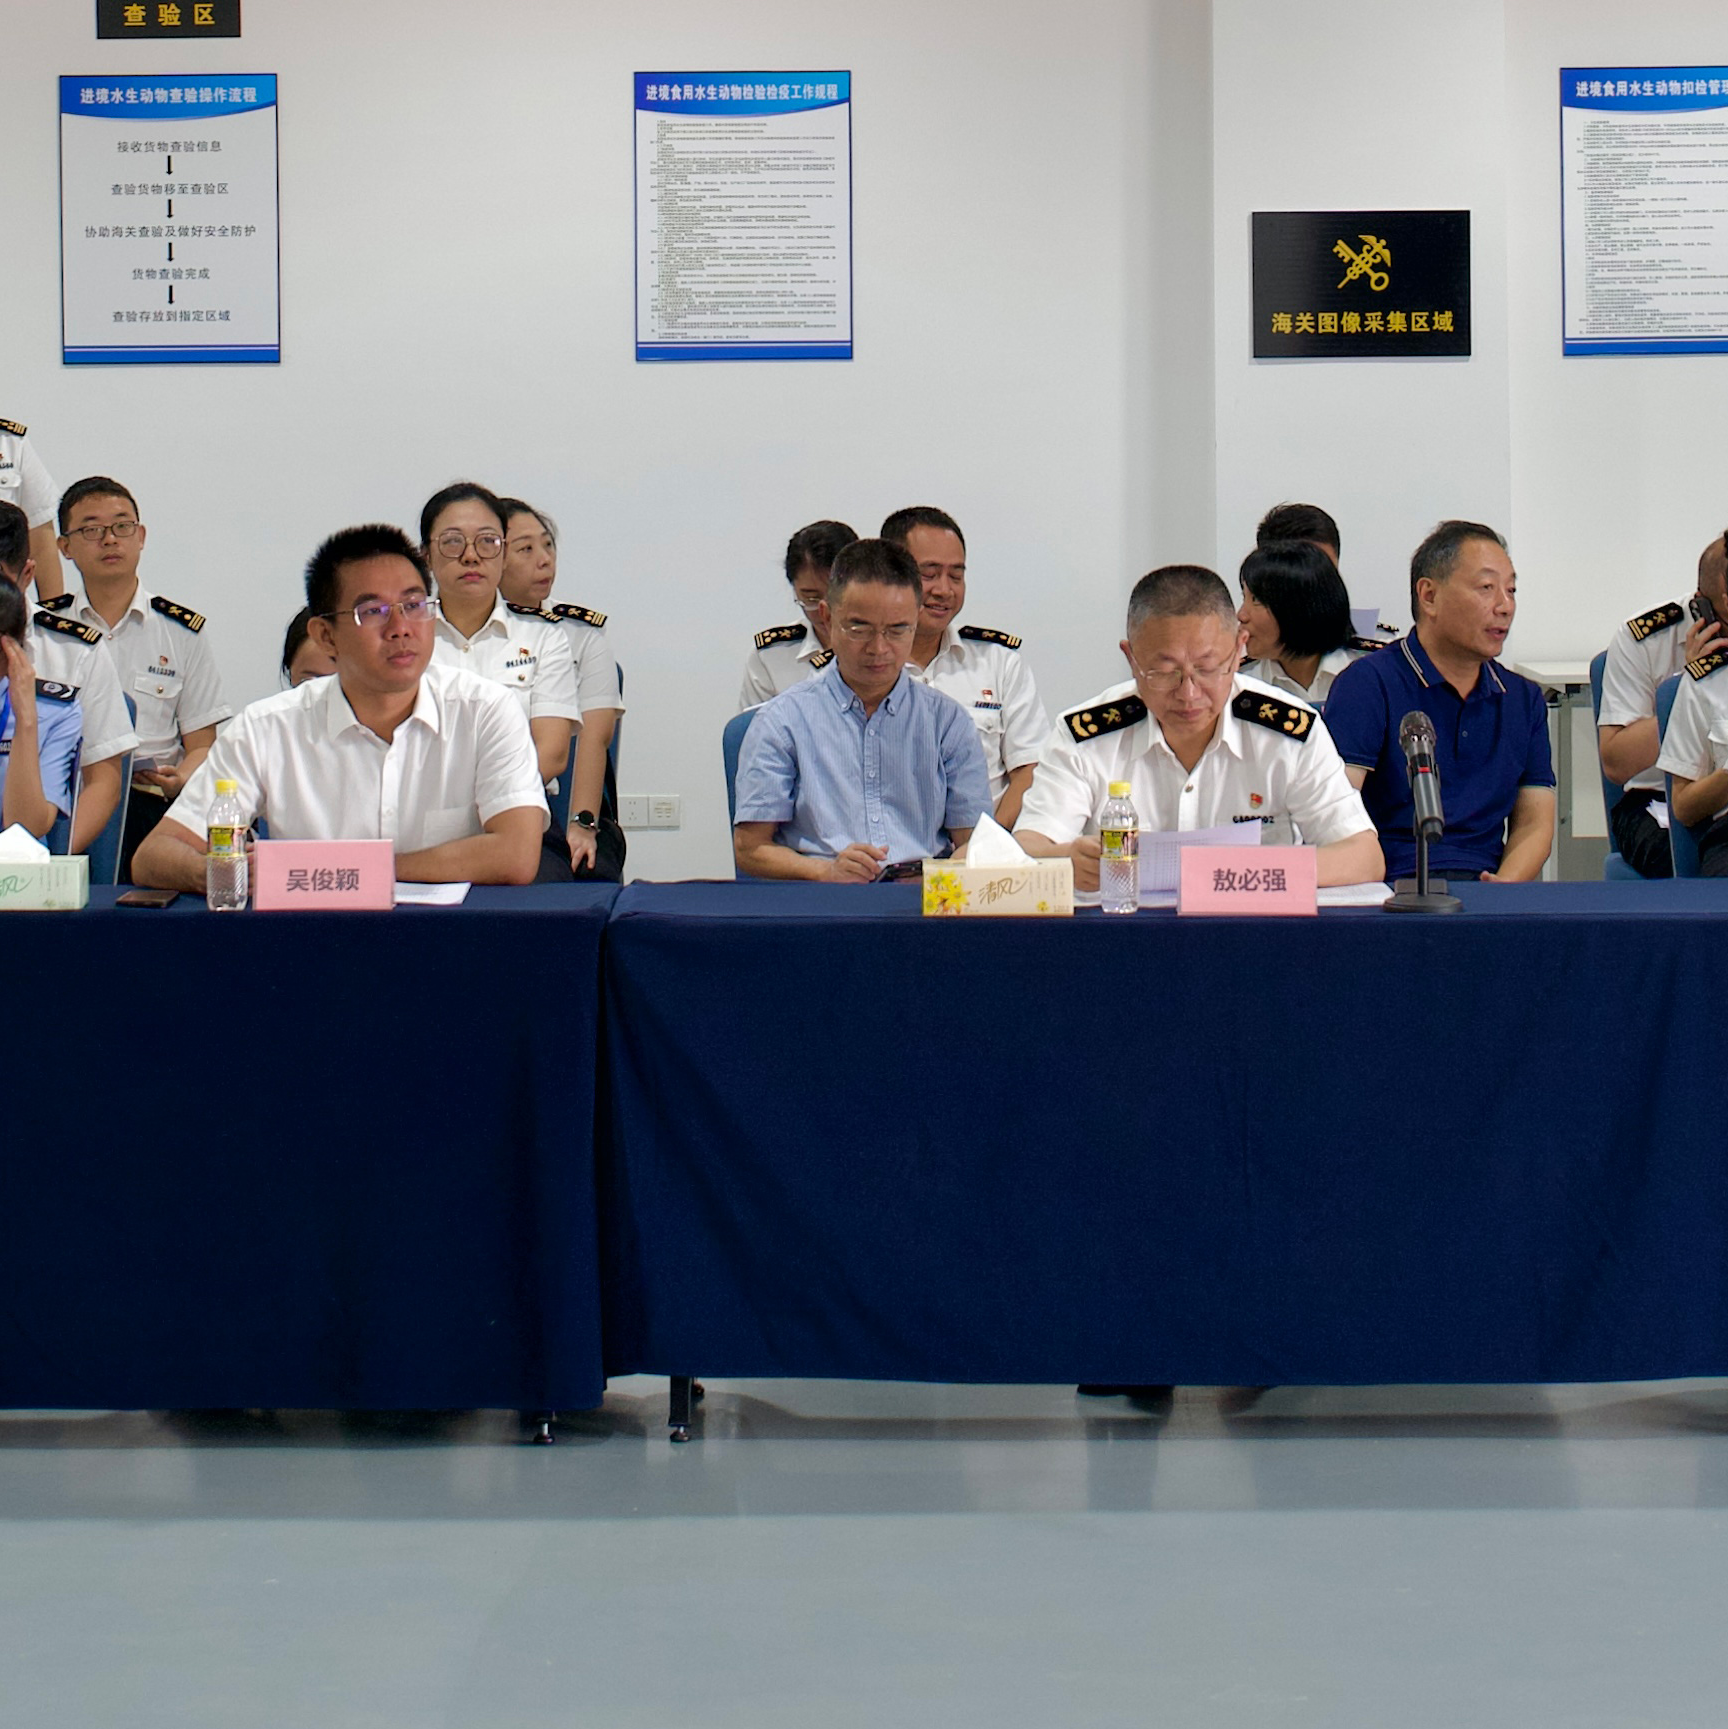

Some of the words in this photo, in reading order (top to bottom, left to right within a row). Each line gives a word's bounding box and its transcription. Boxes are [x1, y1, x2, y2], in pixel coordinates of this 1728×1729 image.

[123, 3, 216, 27] 查验区
[79, 86, 257, 105] 进境水生动物查验操作流程
[646, 83, 839, 101] 进境食用水生动物检验检疫工作规程
[117, 140, 223, 153] 接收货物查验信息
[111, 183, 229, 195] 查验货物移至查验区
[84, 225, 257, 238] 协助海关查验及做好安全防护
[132, 267, 211, 280] 货物查验完成
[112, 310, 231, 323] 查验存放到指定区域
[1271, 310, 1455, 335] 海关图像采集区域
[285, 868, 361, 892] 吴俊颖
[1211, 867, 1288, 893] 敖必强
[978, 874, 1030, 905] 清风
